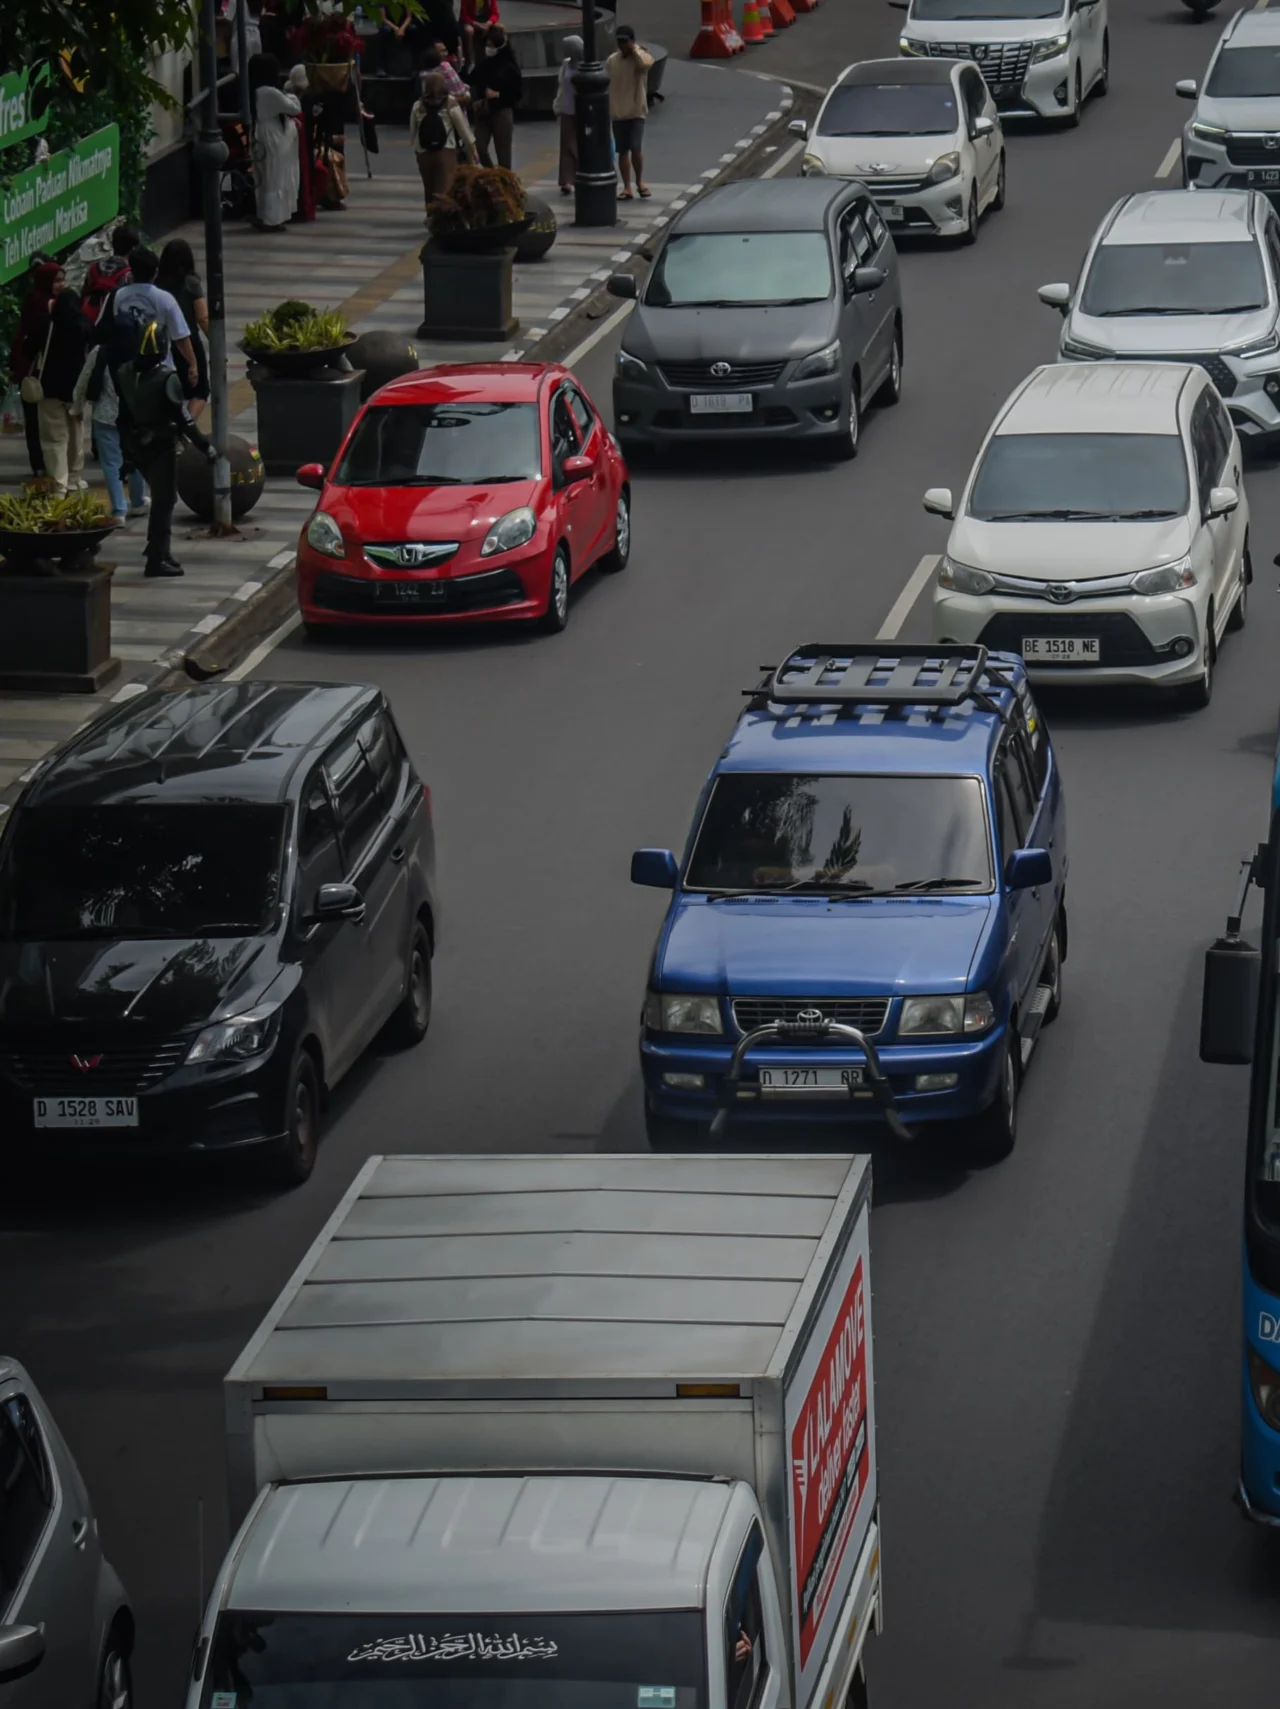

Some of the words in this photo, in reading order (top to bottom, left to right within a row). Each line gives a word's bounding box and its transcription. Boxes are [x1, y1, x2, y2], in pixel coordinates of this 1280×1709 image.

[35, 170, 67, 208] Paduan
[68, 146, 112, 189] Nikmatnya
[3, 233, 20, 268] Teh
[20, 220, 54, 259] Ketemu
[55, 196, 88, 239] Markisa
[1024, 639, 1040, 653] BE
[1045, 639, 1075, 653] 1518
[1082, 639, 1098, 653] NE
[37, 1100, 47, 1117] D
[58, 1100, 97, 1117] 1528
[105, 1100, 134, 1117] SAV
[783, 1070, 819, 1085] 1271
[809, 1280, 865, 1478] LALAMOVE
[817, 1426, 842, 1525] deliver
[841, 1371, 862, 1456] faster
